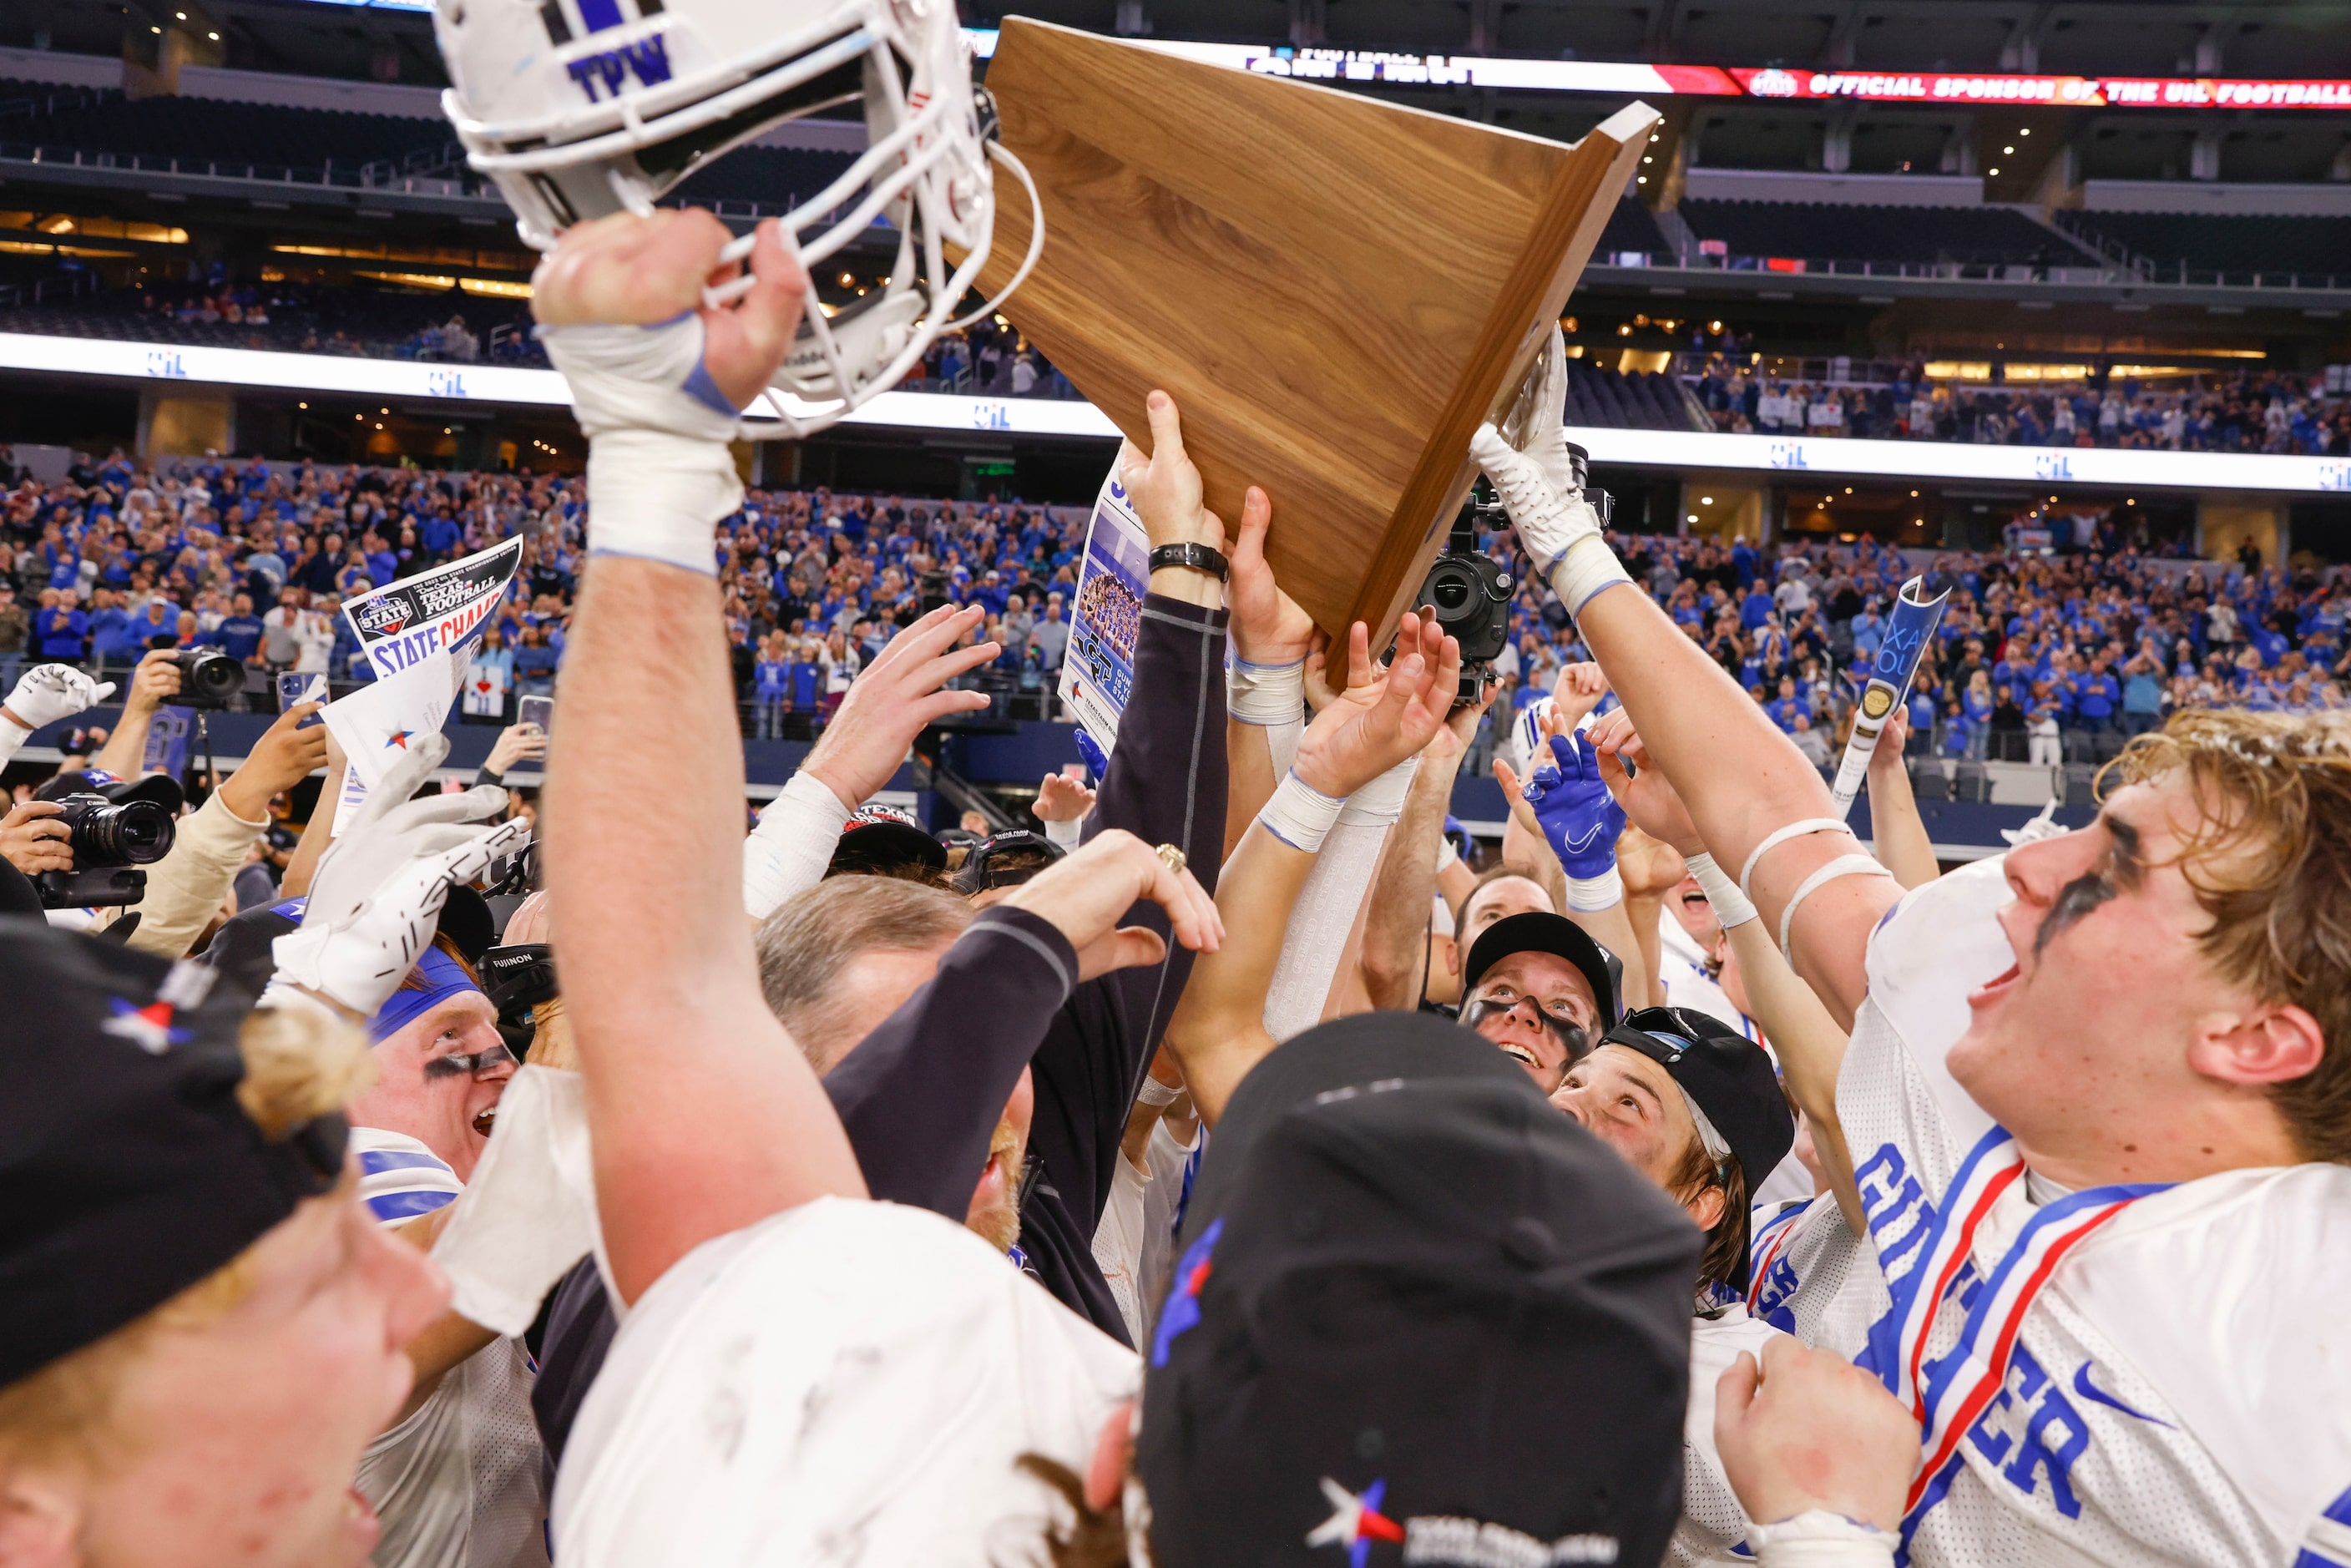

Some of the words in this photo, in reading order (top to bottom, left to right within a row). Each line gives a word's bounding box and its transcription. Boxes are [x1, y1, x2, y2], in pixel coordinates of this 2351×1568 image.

[567, 33, 672, 104] TPW
[1809, 73, 1926, 97] OFFICIAL
[1933, 78, 2055, 100] SPONSOR
[2061, 80, 2101, 101] OF
[2105, 80, 2160, 103] THE
[2164, 81, 2211, 104] UIL
[2216, 83, 2351, 105] FOOTBALL
[466, 554, 500, 572] CHAMPIONSHIP
[419, 580, 464, 605] TEXAS
[425, 575, 496, 616] FOOTBALL
[361, 604, 410, 629] STATE
[374, 626, 438, 678] STATE
[1115, 680, 1122, 690] IS
[1116, 669, 1133, 686] GUN
[1085, 697, 1099, 717] TEXAS
[1098, 711, 1109, 727] FARM
[861, 804, 916, 827] TEXAS
[493, 953, 533, 969] FUJINON
